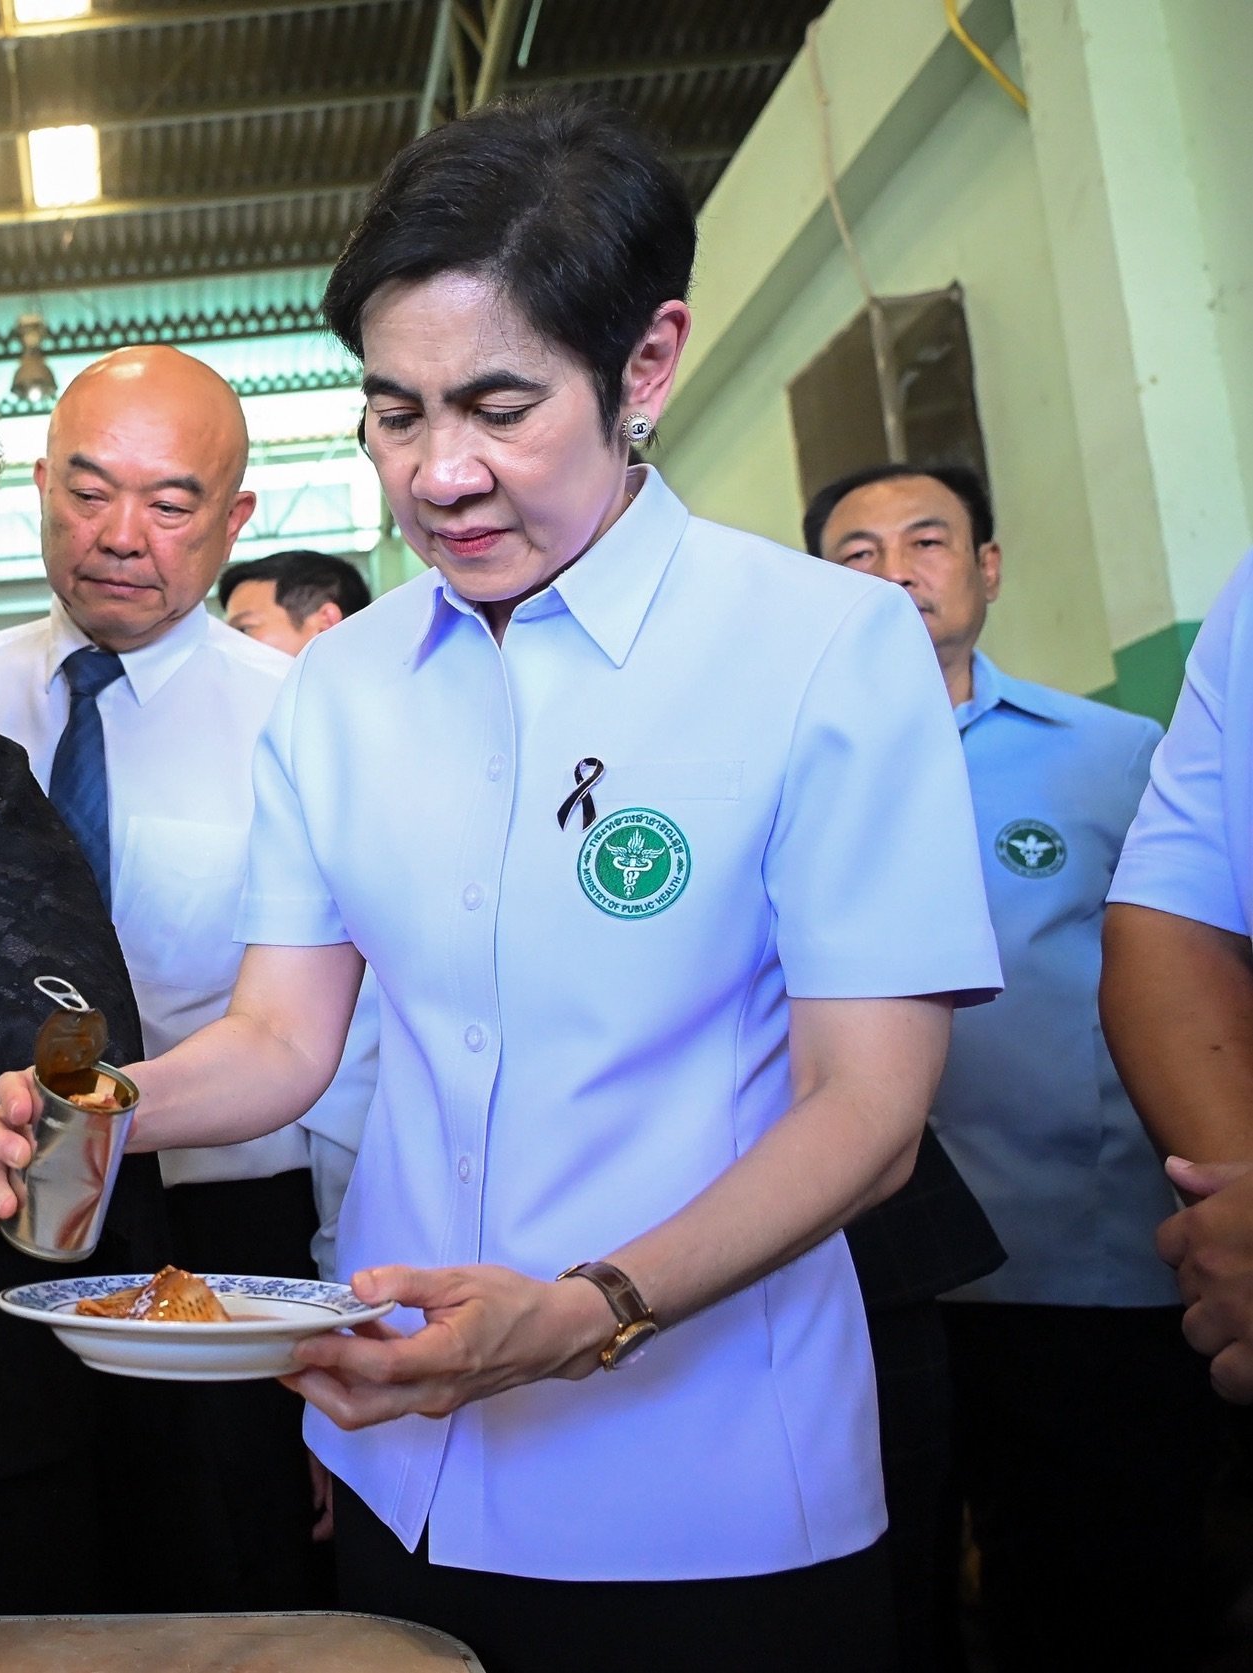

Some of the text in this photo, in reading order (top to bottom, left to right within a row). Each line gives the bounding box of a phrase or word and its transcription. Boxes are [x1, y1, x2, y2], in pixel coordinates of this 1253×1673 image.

[589, 813, 684, 855] กระทรวงสาธารณสุข
[583, 867, 682, 914] MINISTRY OF PUBLIC HEALTH
